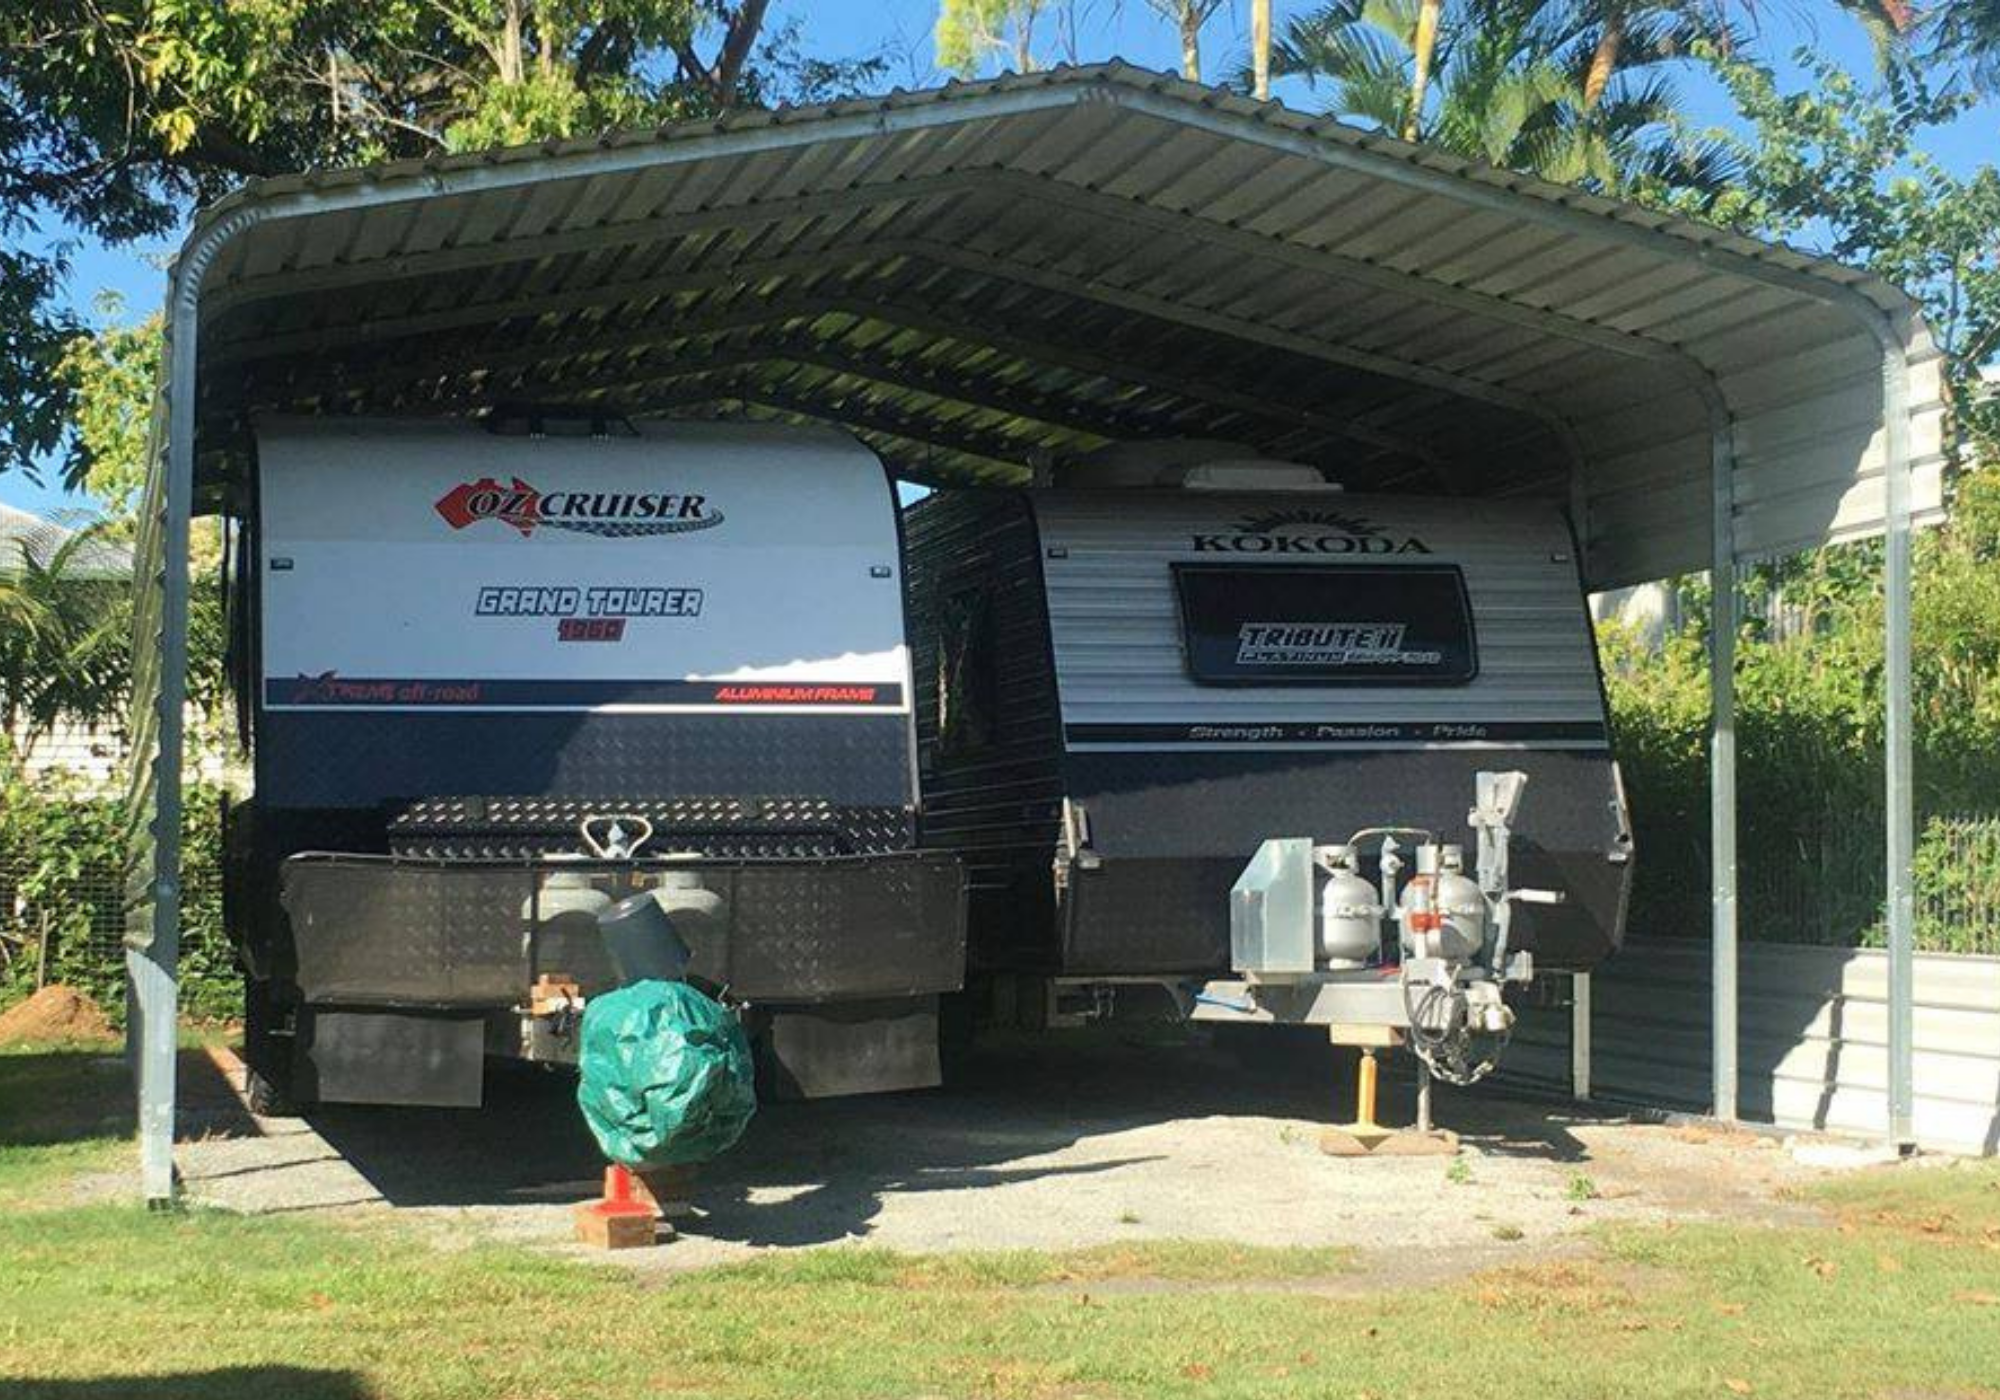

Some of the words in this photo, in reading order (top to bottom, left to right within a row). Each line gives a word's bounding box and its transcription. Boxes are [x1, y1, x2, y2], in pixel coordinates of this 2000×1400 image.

[468, 490, 536, 517] OZ
[539, 491, 706, 518] CRUISER
[1191, 533, 1434, 554] KOKODA
[474, 586, 580, 616] GRAND
[587, 587, 705, 617] TOURER
[1246, 626, 1374, 648] TRIBUTE
[715, 687, 814, 701] ALUMINIUM
[814, 688, 876, 701] FRAME
[1189, 725, 1284, 740] Strength
[1316, 725, 1399, 738] Passion
[1432, 725, 1488, 738] Pride
